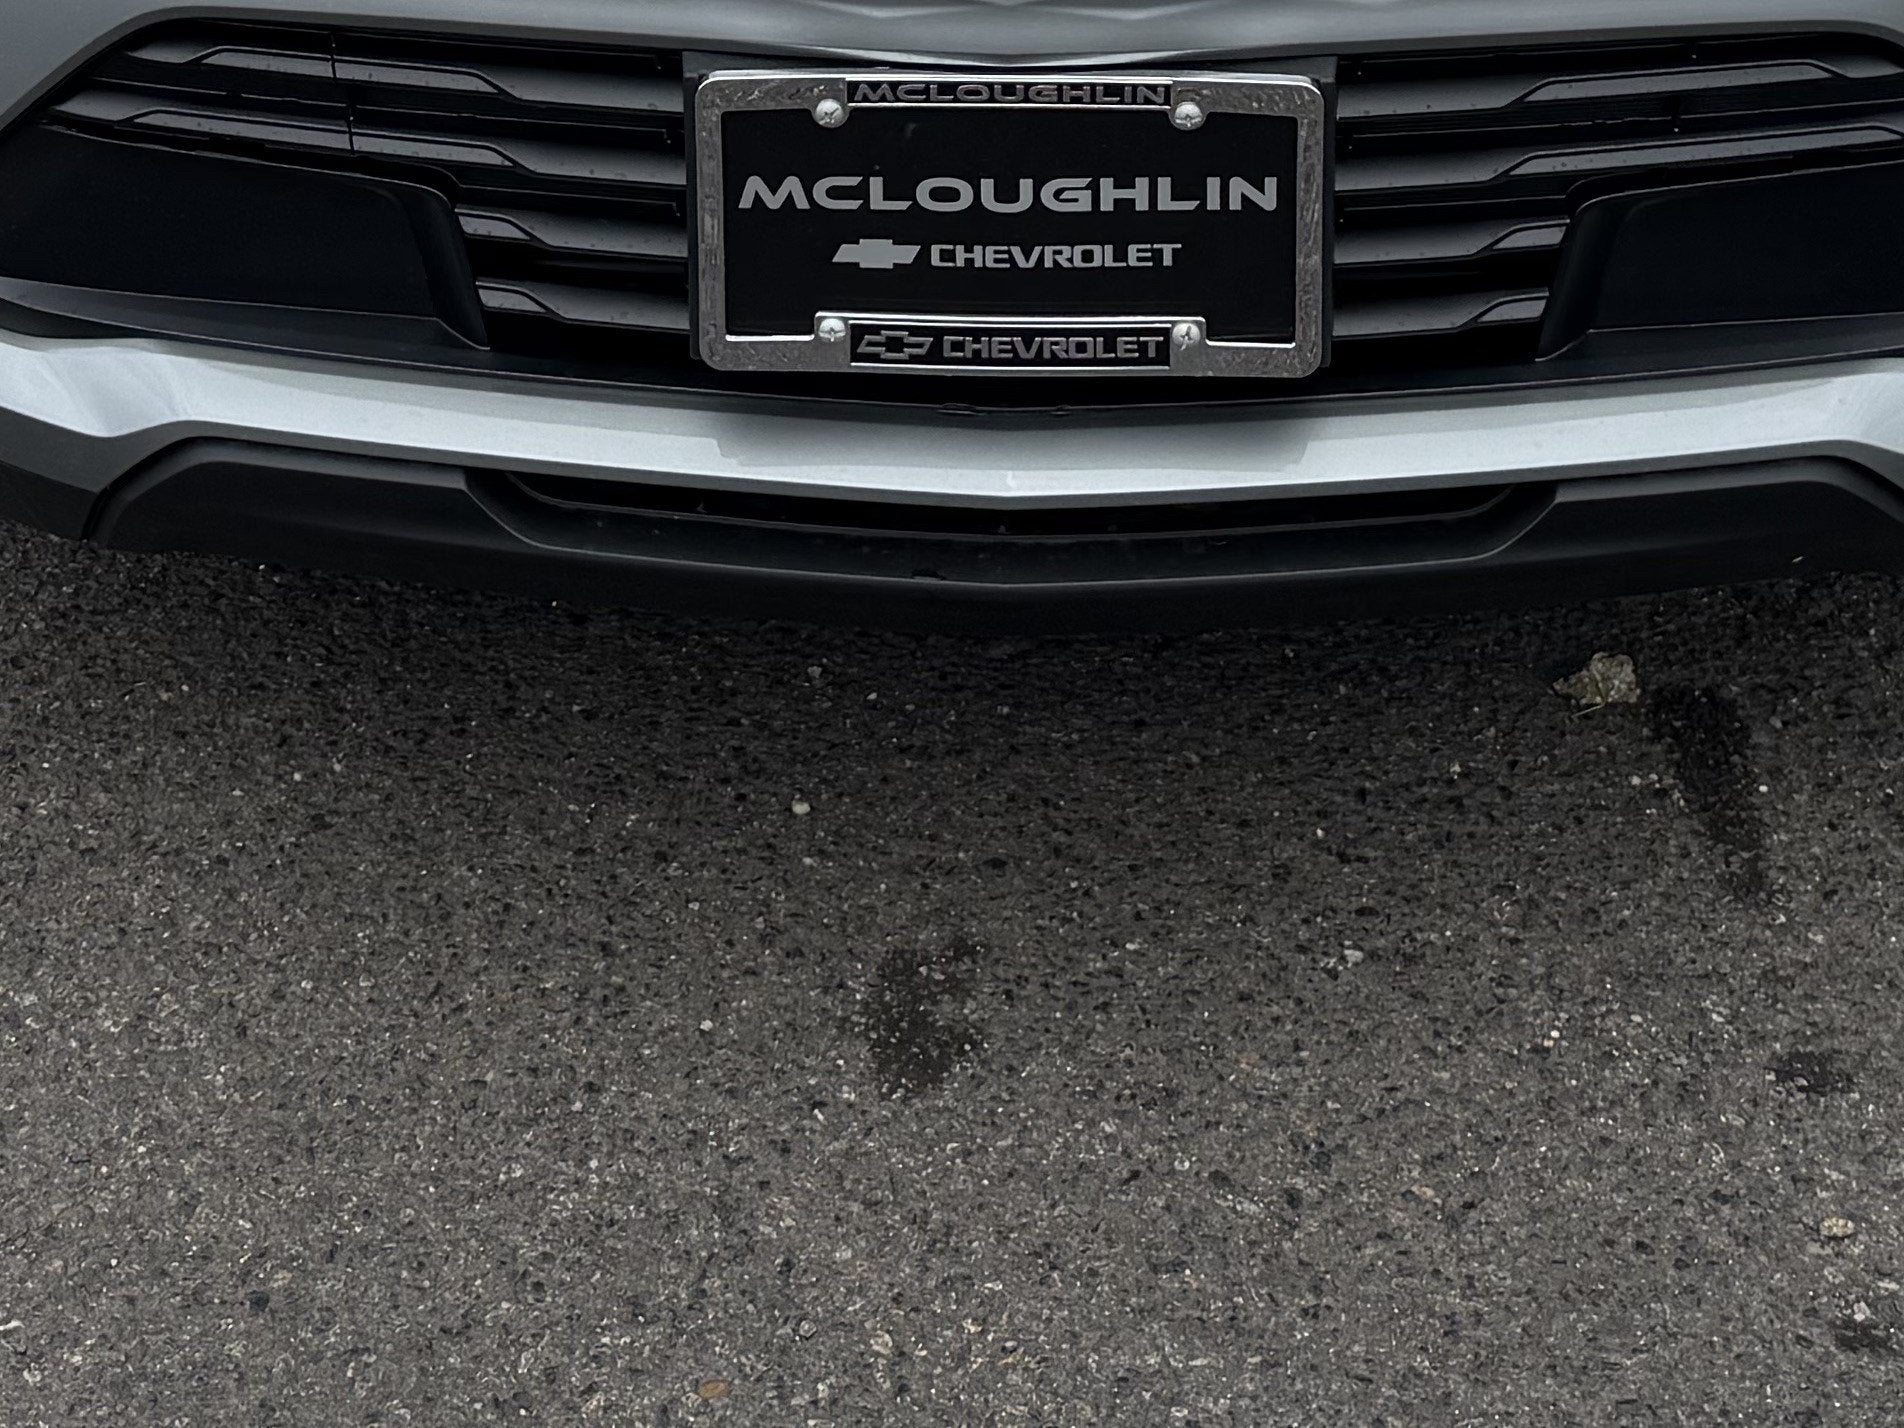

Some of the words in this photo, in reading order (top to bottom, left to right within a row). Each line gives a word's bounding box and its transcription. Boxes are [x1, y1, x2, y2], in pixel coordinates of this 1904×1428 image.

[853, 82, 1166, 105] MCLOUGHLIN
[738, 175, 1277, 213] MCLOUGHLIN
[930, 243, 1182, 267] CHEVROLET
[942, 336, 1164, 359] CHEVROLET
